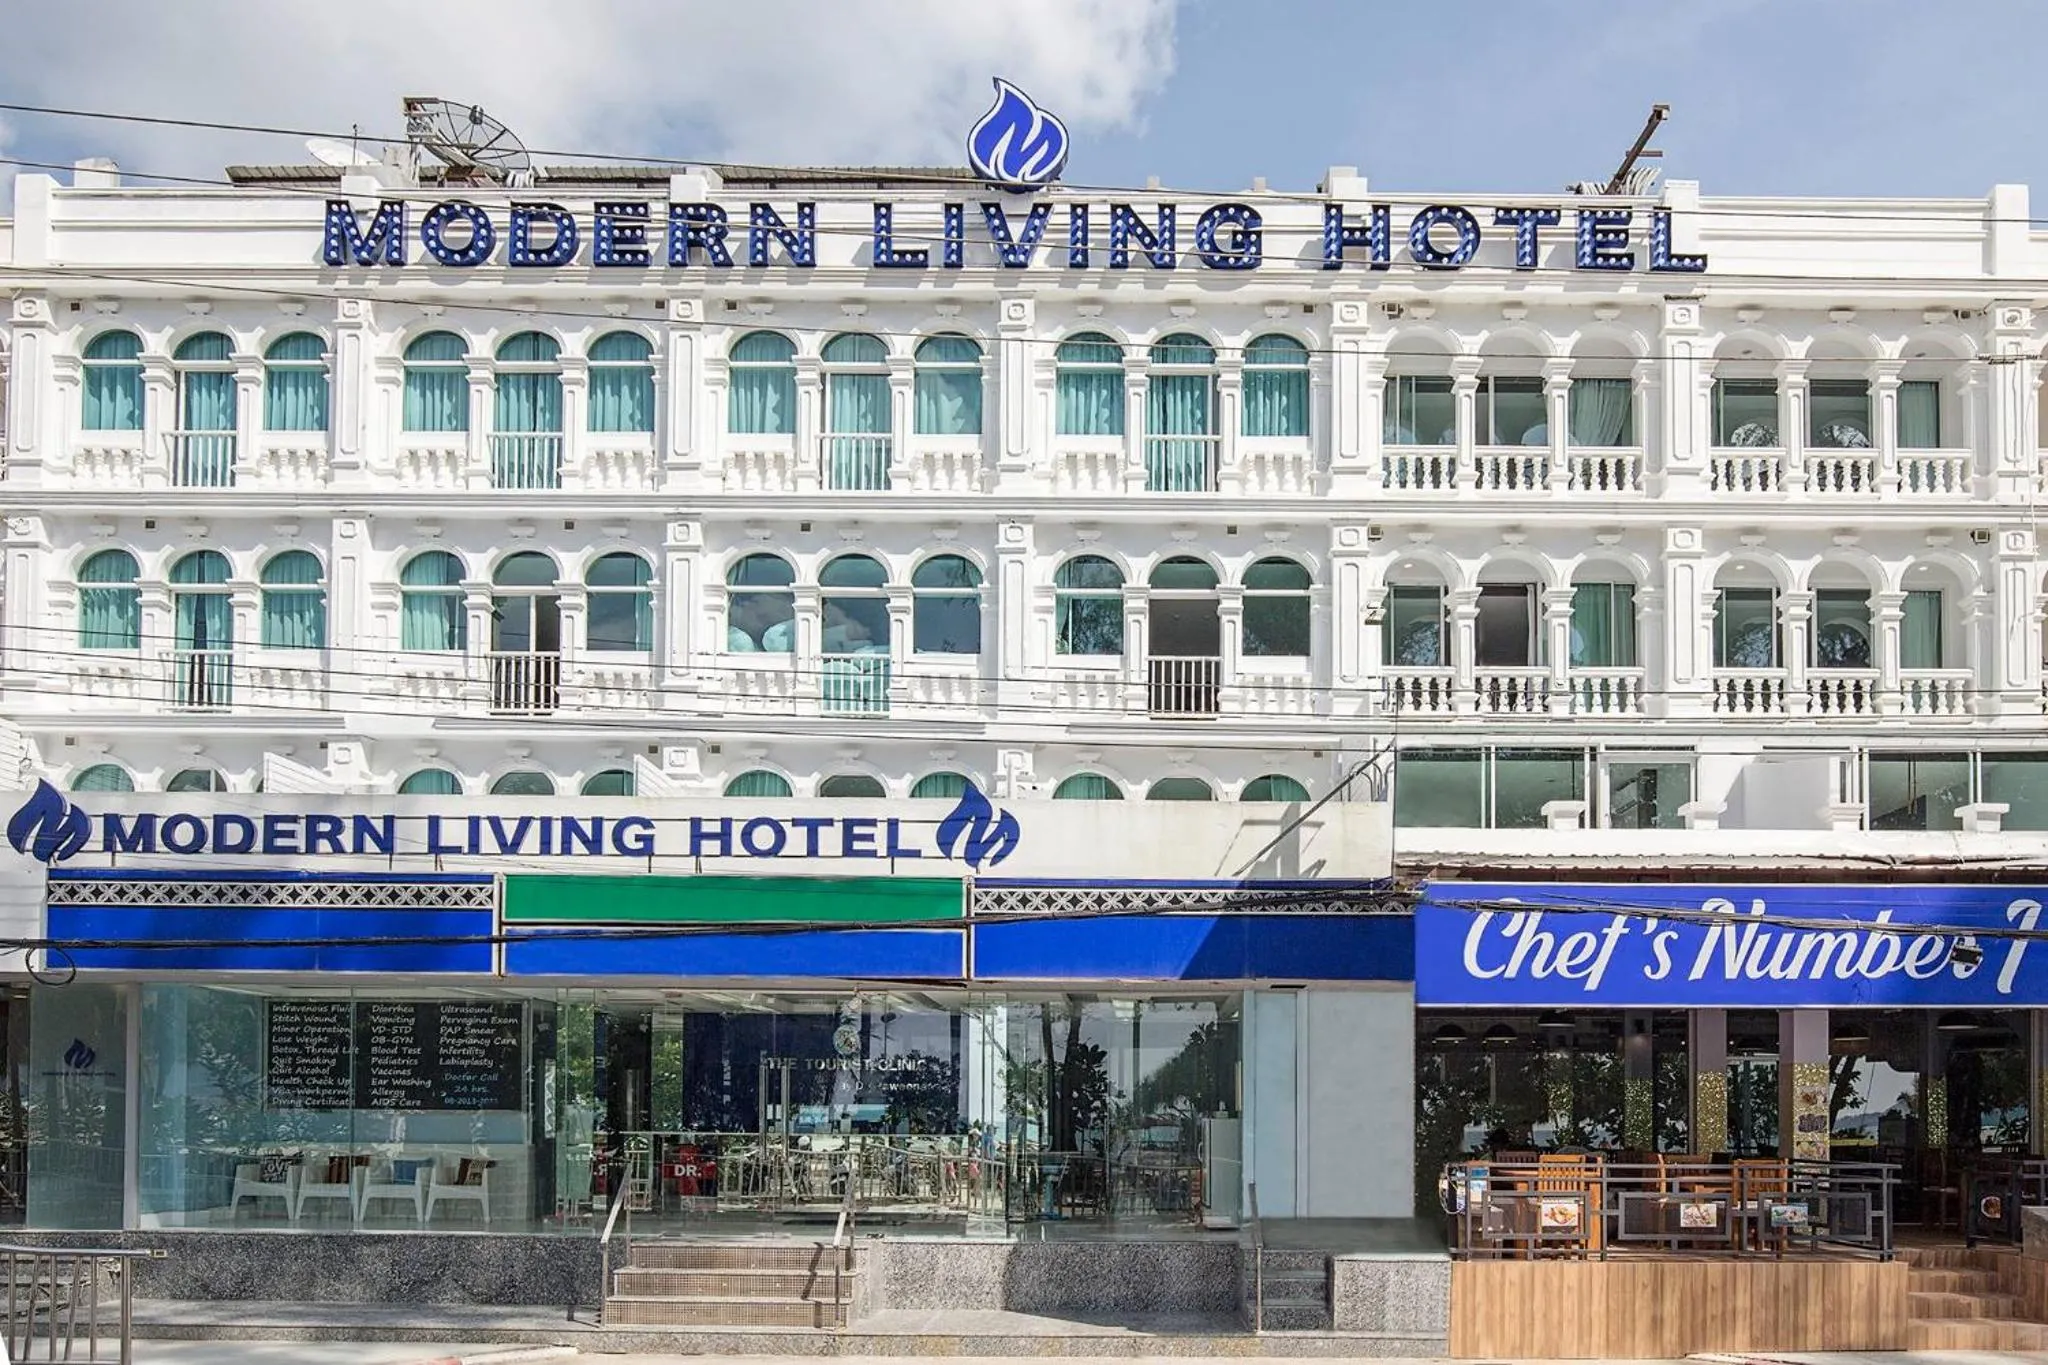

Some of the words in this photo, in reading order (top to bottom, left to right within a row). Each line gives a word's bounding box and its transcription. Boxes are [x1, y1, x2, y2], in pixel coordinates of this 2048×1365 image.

[323, 199, 816, 267] MODERN
[873, 202, 1262, 269] LIVING
[1323, 203, 1708, 273] HOTEL
[102, 812, 395, 855] MODERN
[427, 814, 656, 858] LIVING
[690, 816, 922, 860] HOTEL
[1463, 898, 1679, 991] Chef's
[440, 1004, 493, 1014] Ultrasound
[272, 1014, 301, 1023] Stitch
[304, 1014, 337, 1023] Wound
[371, 1015, 415, 1026] Vomiting
[491, 1015, 519, 1025] Exam
[272, 1025, 300, 1033] Minor
[371, 1025, 412, 1034] VD-STD
[440, 1025, 461, 1035] PAP
[464, 1025, 496, 1035] Smear
[272, 1035, 292, 1043] Lose
[296, 1034, 328, 1046] Weight
[371, 1035, 413, 1044] OB-GYN
[439, 1036, 491, 1047] Pregnancy
[494, 1036, 518, 1046] Care
[305, 1045, 339, 1054] Thread
[371, 1046, 397, 1055] Blood
[401, 1046, 421, 1055] Test
[439, 1046, 486, 1058] Infertility
[272, 1056, 293, 1066] Quit
[296, 1056, 337, 1066] Smoking
[371, 1056, 418, 1066] Pediatrics
[439, 1056, 494, 1068] Labiaplasty
[768, 1057, 798, 1070] THE
[805, 1057, 872, 1071] TOURST
[272, 1065, 293, 1075] Quit
[295, 1065, 330, 1075] Alcohol
[371, 1067, 412, 1076] Vaccines
[272, 1076, 302, 1085] Health
[305, 1076, 334, 1085] Check
[371, 1077, 388, 1086] Ear
[391, 1077, 432, 1088] Washing
[371, 1087, 405, 1098] Allergy
[305, 1096, 354, 1106] Certificat
[371, 1098, 396, 1106] AIDS
[400, 1098, 421, 1107] Care
[674, 1164, 702, 1177] DR.
